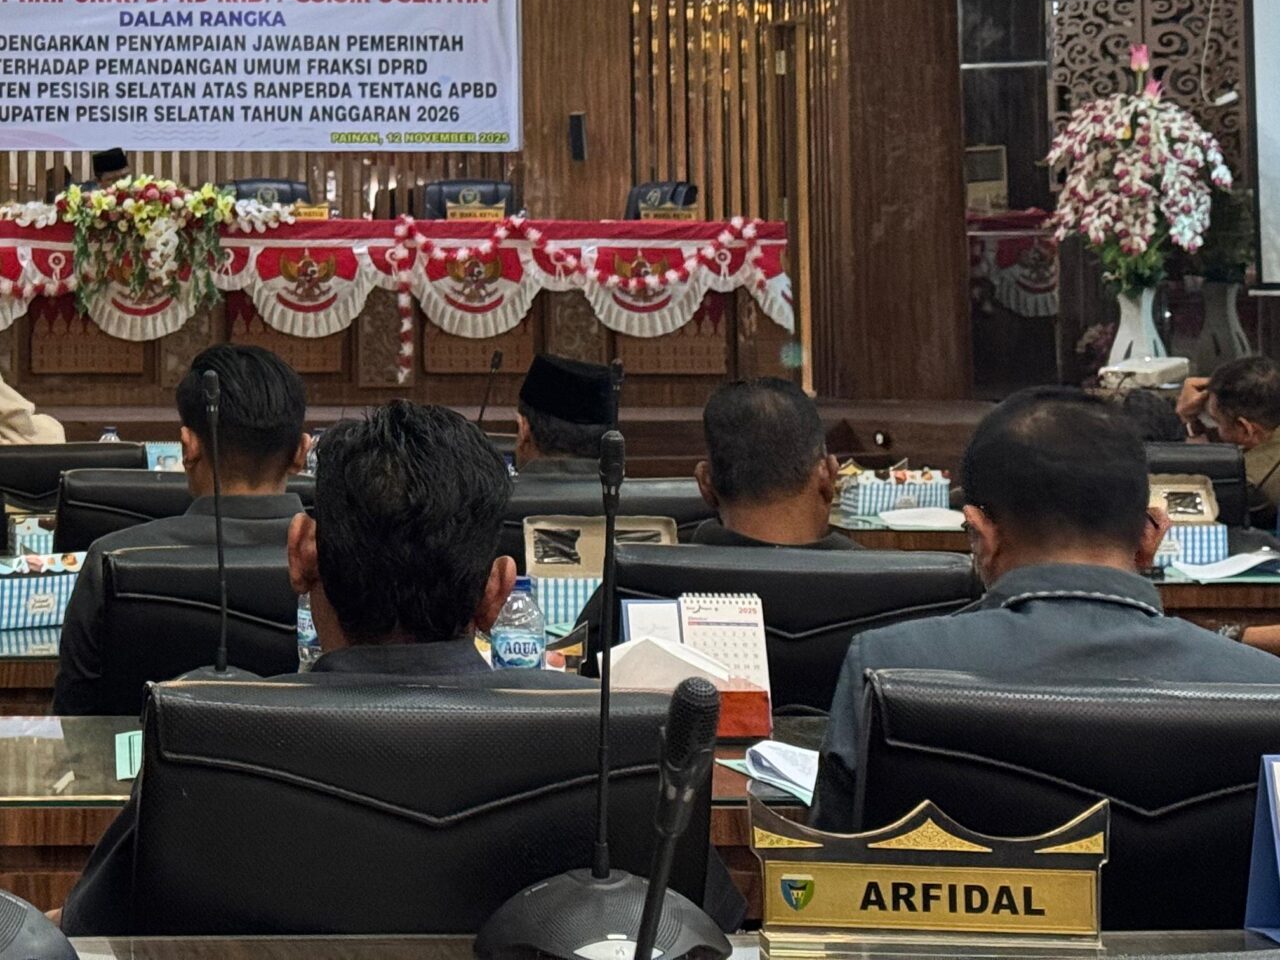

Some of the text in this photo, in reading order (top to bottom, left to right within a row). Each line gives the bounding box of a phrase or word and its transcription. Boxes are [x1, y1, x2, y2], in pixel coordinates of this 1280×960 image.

[120, 11, 286, 27] DALAM RANGKA
[116, 35, 246, 52] PENYAMPAIAN
[252, 35, 340, 52] JAWABAN
[347, 35, 464, 52] PEMERINTAH
[95, 58, 237, 75] PEMANDANGAN
[244, 58, 300, 75] UMUM
[307, 58, 371, 75] FRAKSI
[378, 58, 428, 75] DPRD
[38, 82, 109, 99] PESISIR
[115, 82, 195, 99] SELATAN
[202, 82, 247, 99] ATAS
[254, 82, 352, 99] RANPERDA
[358, 82, 442, 99] TENTANG
[448, 82, 497, 99] APBD
[76, 105, 147, 122] PESISIR
[154, 105, 234, 122] SELATAN
[241, 105, 302, 122] TAHUN
[309, 105, 410, 122] ANGGARAN
[417, 105, 460, 122] 2026
[331, 132, 383, 145] PAINAN,
[386, 132, 402, 143] 12
[404, 132, 476, 143] NOVEMBER
[503, 641, 539, 658] AQUA
[860, 881, 1045, 916] ARFIDAL
